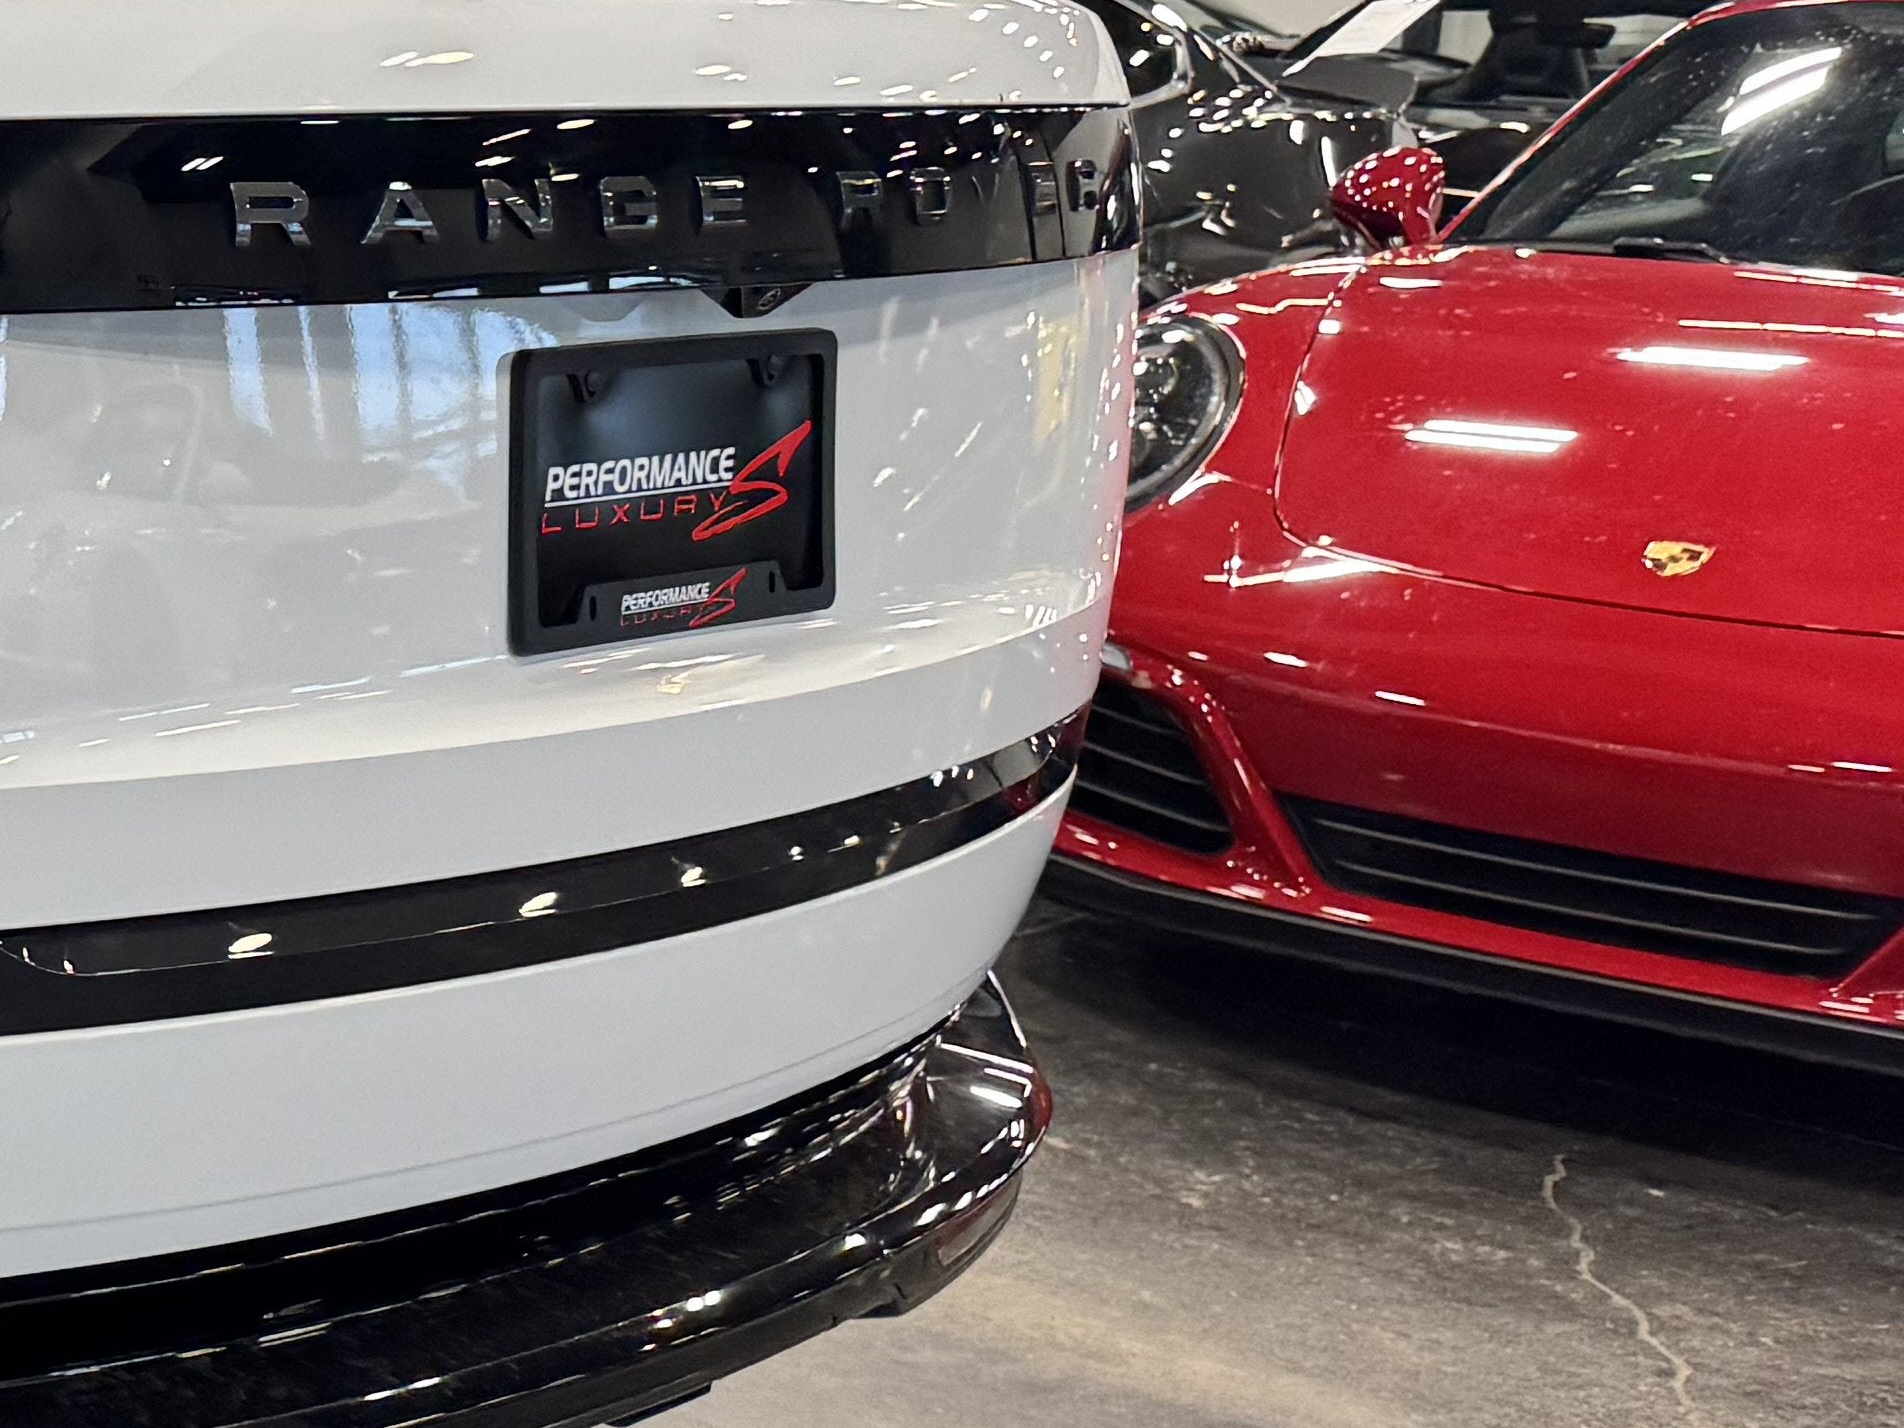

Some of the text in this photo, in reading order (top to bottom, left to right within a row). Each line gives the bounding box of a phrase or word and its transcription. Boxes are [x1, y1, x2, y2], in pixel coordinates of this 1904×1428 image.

[229, 174, 748, 248] RANGE
[544, 446, 736, 503] PERFORMANCE
[540, 490, 728, 535] LUXURY
[620, 581, 711, 613] PERFORMANCE
